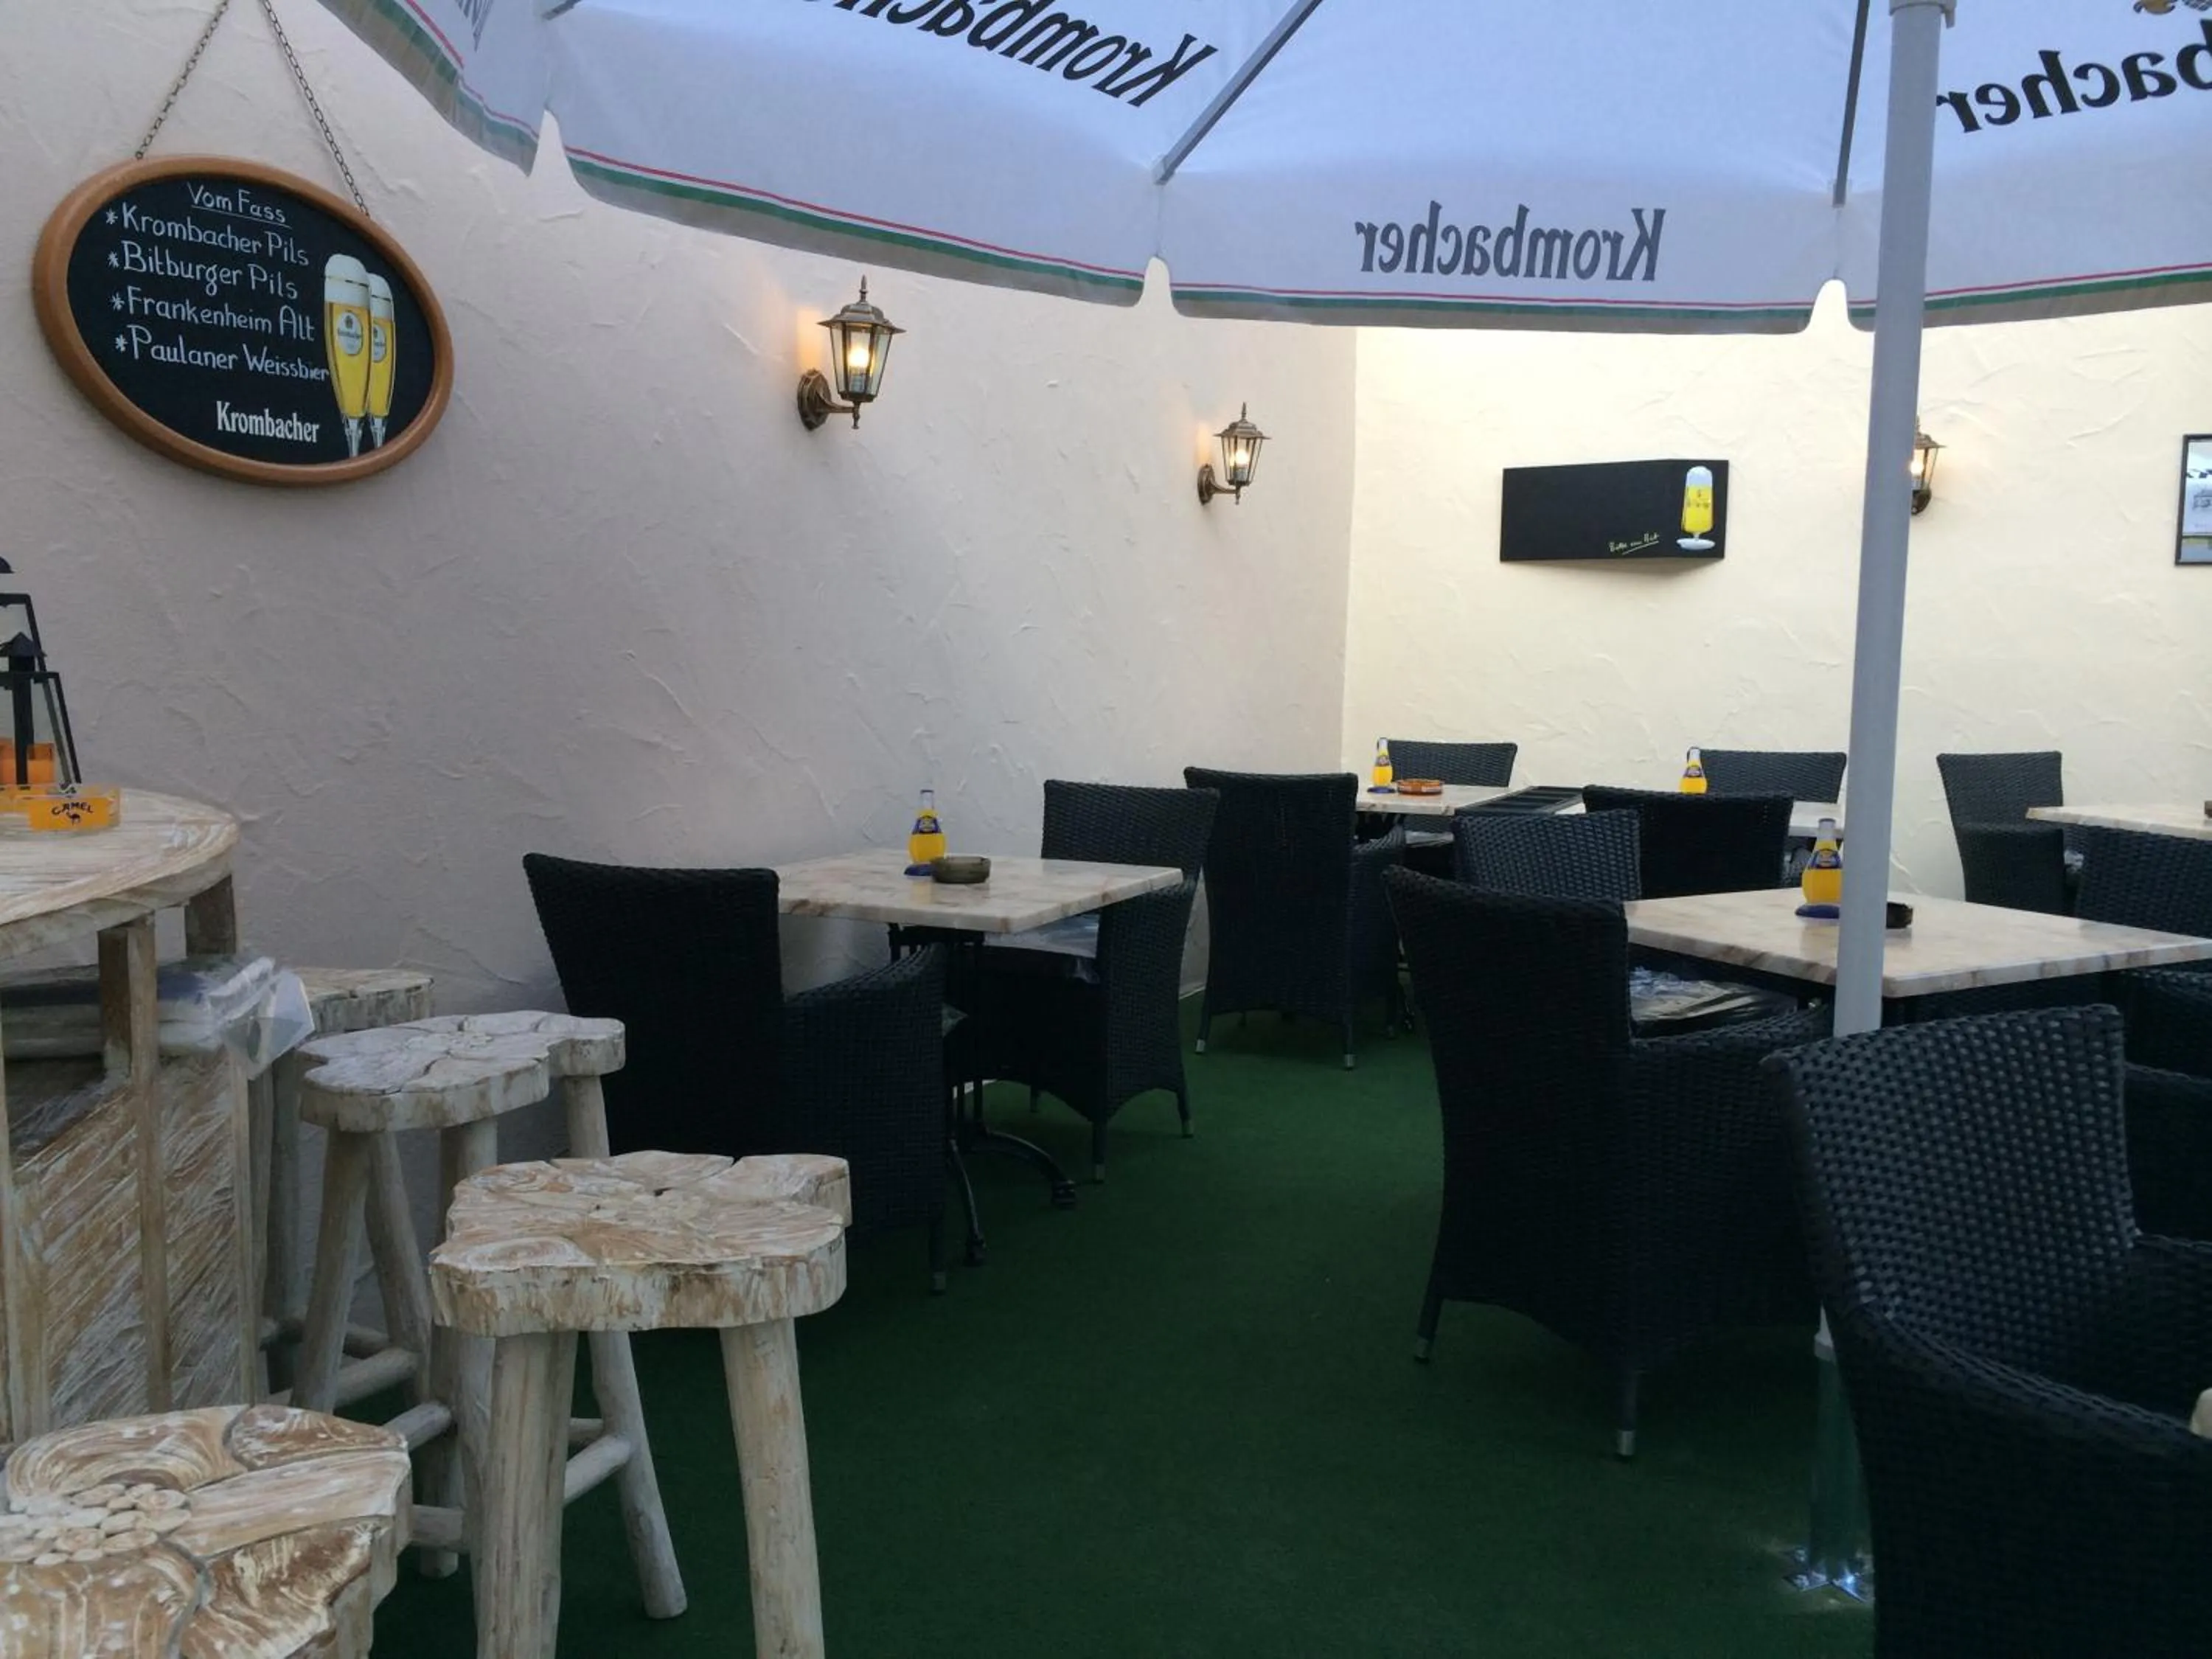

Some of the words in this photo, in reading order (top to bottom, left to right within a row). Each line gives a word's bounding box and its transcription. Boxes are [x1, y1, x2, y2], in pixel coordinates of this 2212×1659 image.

[187, 183, 233, 212] Vom
[237, 189, 286, 223] Fass
[122, 202, 262, 254] Krombacher
[265, 232, 309, 266] Pils
[121, 240, 242, 295] Bitburger
[248, 263, 297, 299] Pils
[127, 286, 272, 333] Frankenheim
[279, 306, 315, 341] Alt
[126, 324, 238, 369] Paulaner
[243, 344, 329, 380] Weissbier
[216, 400, 319, 442] Krombacher
[52, 801, 94, 815] CAMEL
